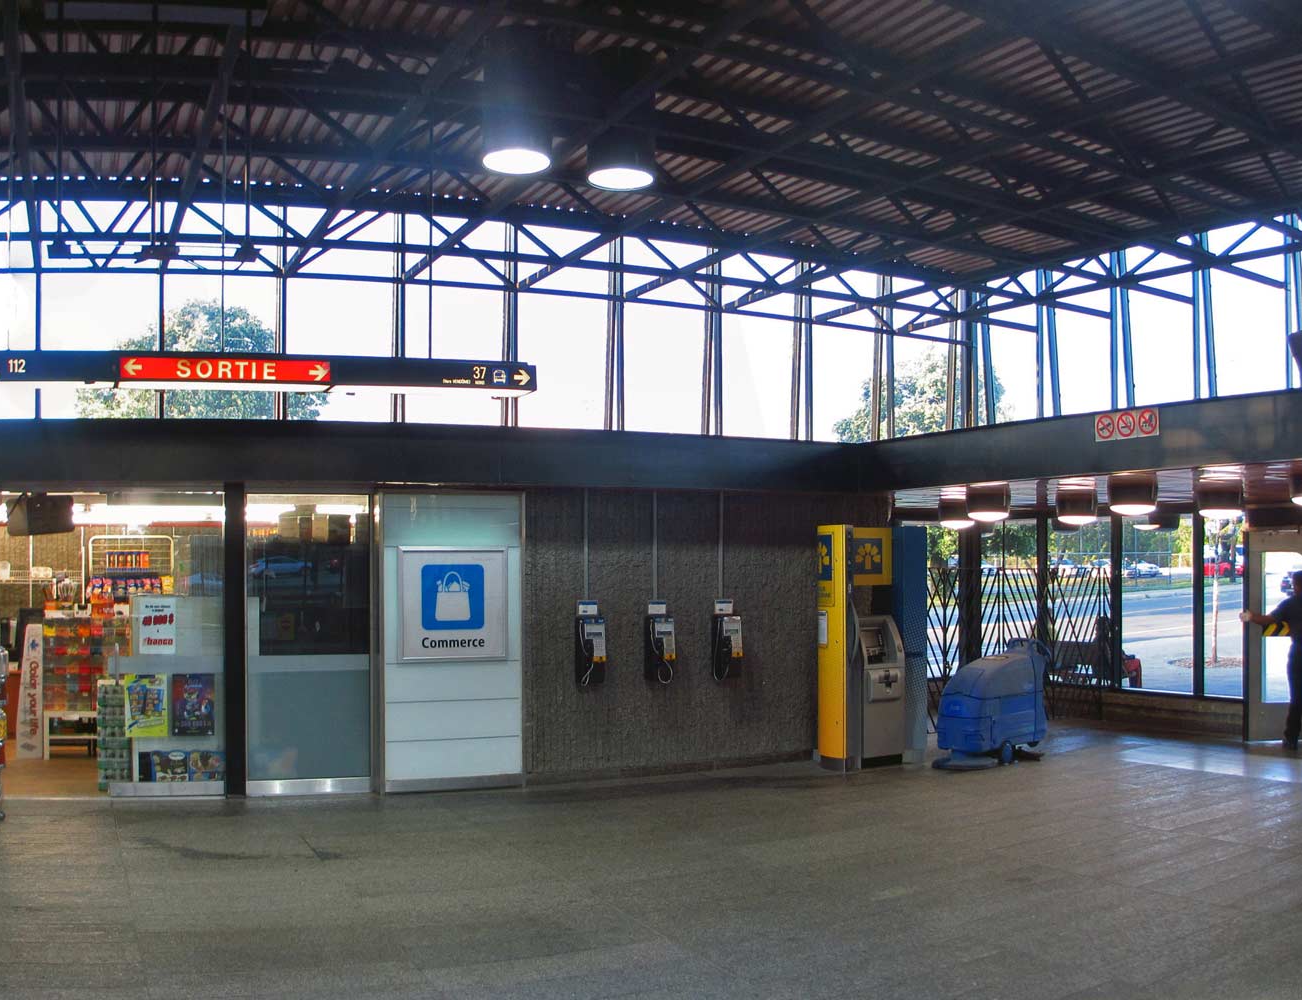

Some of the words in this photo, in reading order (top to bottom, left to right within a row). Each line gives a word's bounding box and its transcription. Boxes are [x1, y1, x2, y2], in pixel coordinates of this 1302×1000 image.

[7, 359, 27, 373] 112
[176, 359, 277, 381] SORTIE
[472, 366, 487, 380] 37
[421, 637, 486, 649] Commerce
[29, 660, 39, 689] Color
[27, 692, 38, 717] your
[29, 718, 39, 736] life
